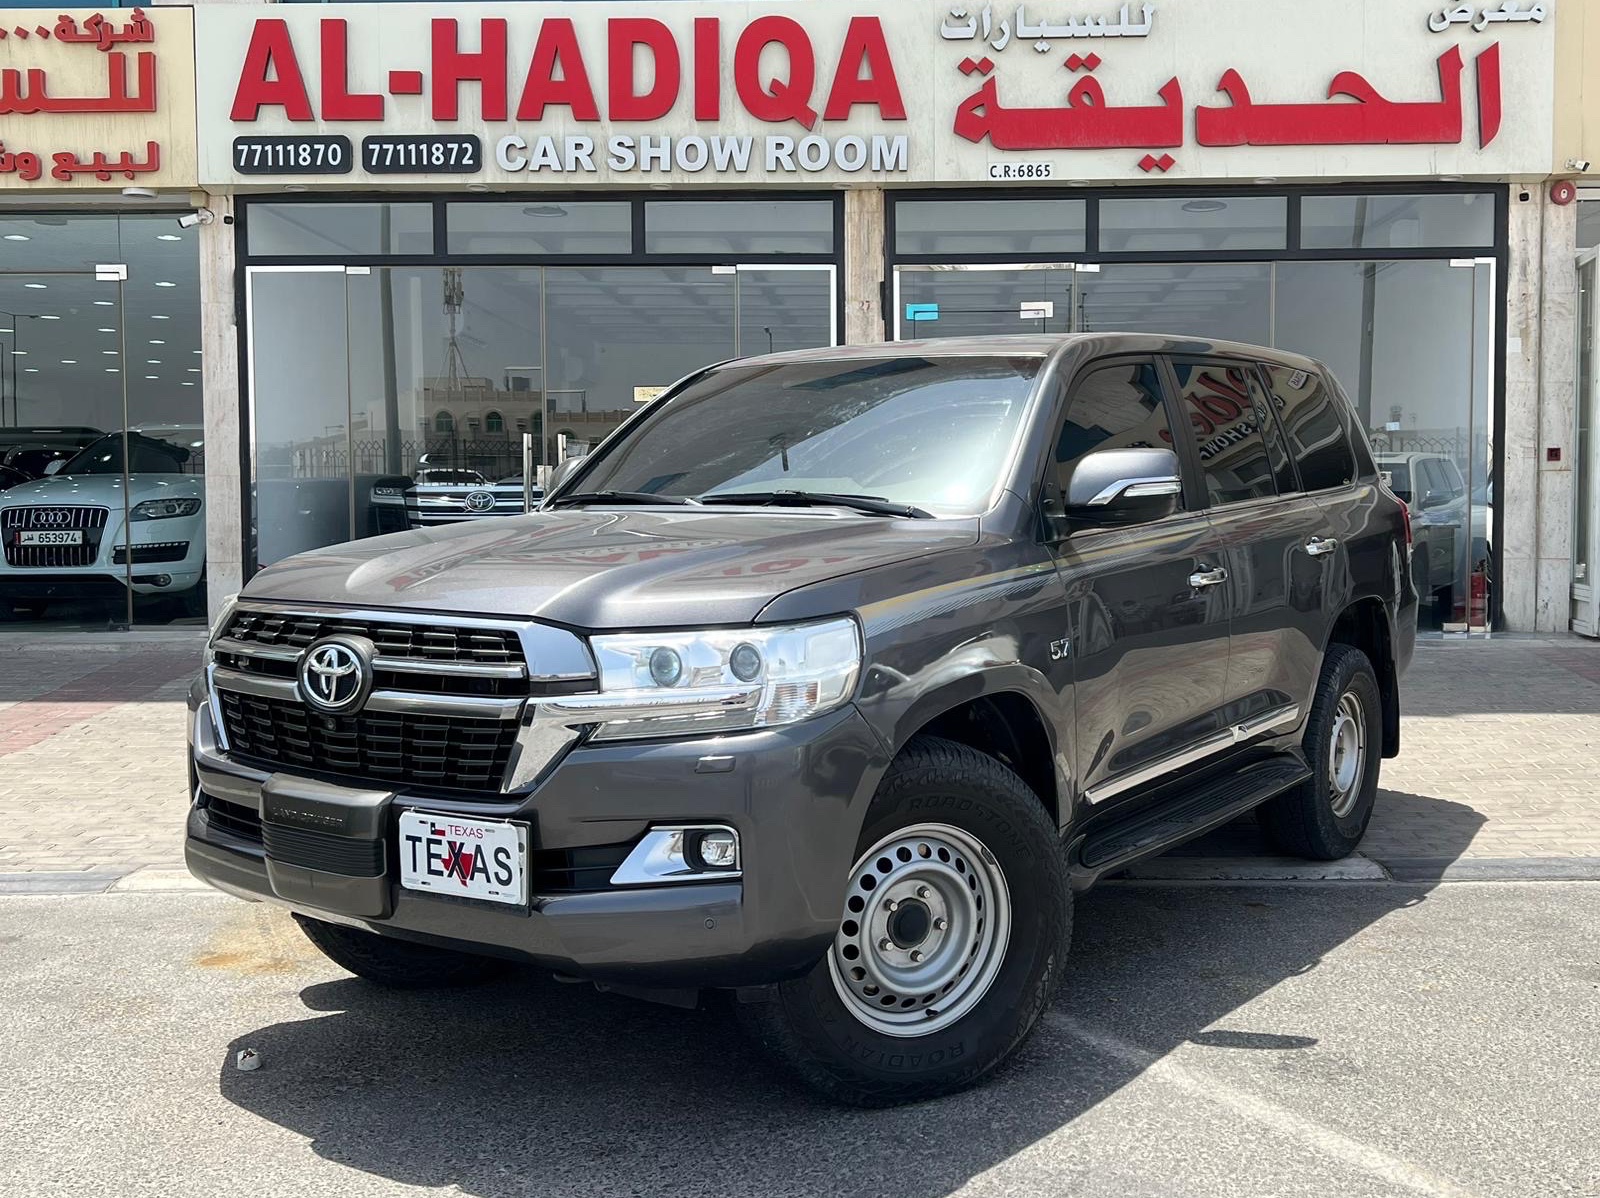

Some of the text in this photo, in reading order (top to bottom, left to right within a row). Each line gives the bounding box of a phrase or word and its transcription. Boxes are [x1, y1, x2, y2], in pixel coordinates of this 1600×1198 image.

[940, 2, 1155, 53] للسيارات
[229, 15, 907, 131] AL-HADIQA
[953, 41, 1502, 173] الحديقة
[237, 143, 342, 166] 77111870
[368, 143, 474, 166] 77111872
[495, 134, 909, 172] CAR SHOW ROOM
[989, 163, 1052, 179] C.R:6865
[38, 532, 77, 544] 653974
[447, 824, 484, 839] TEXAS
[405, 834, 513, 887] TEXAS
